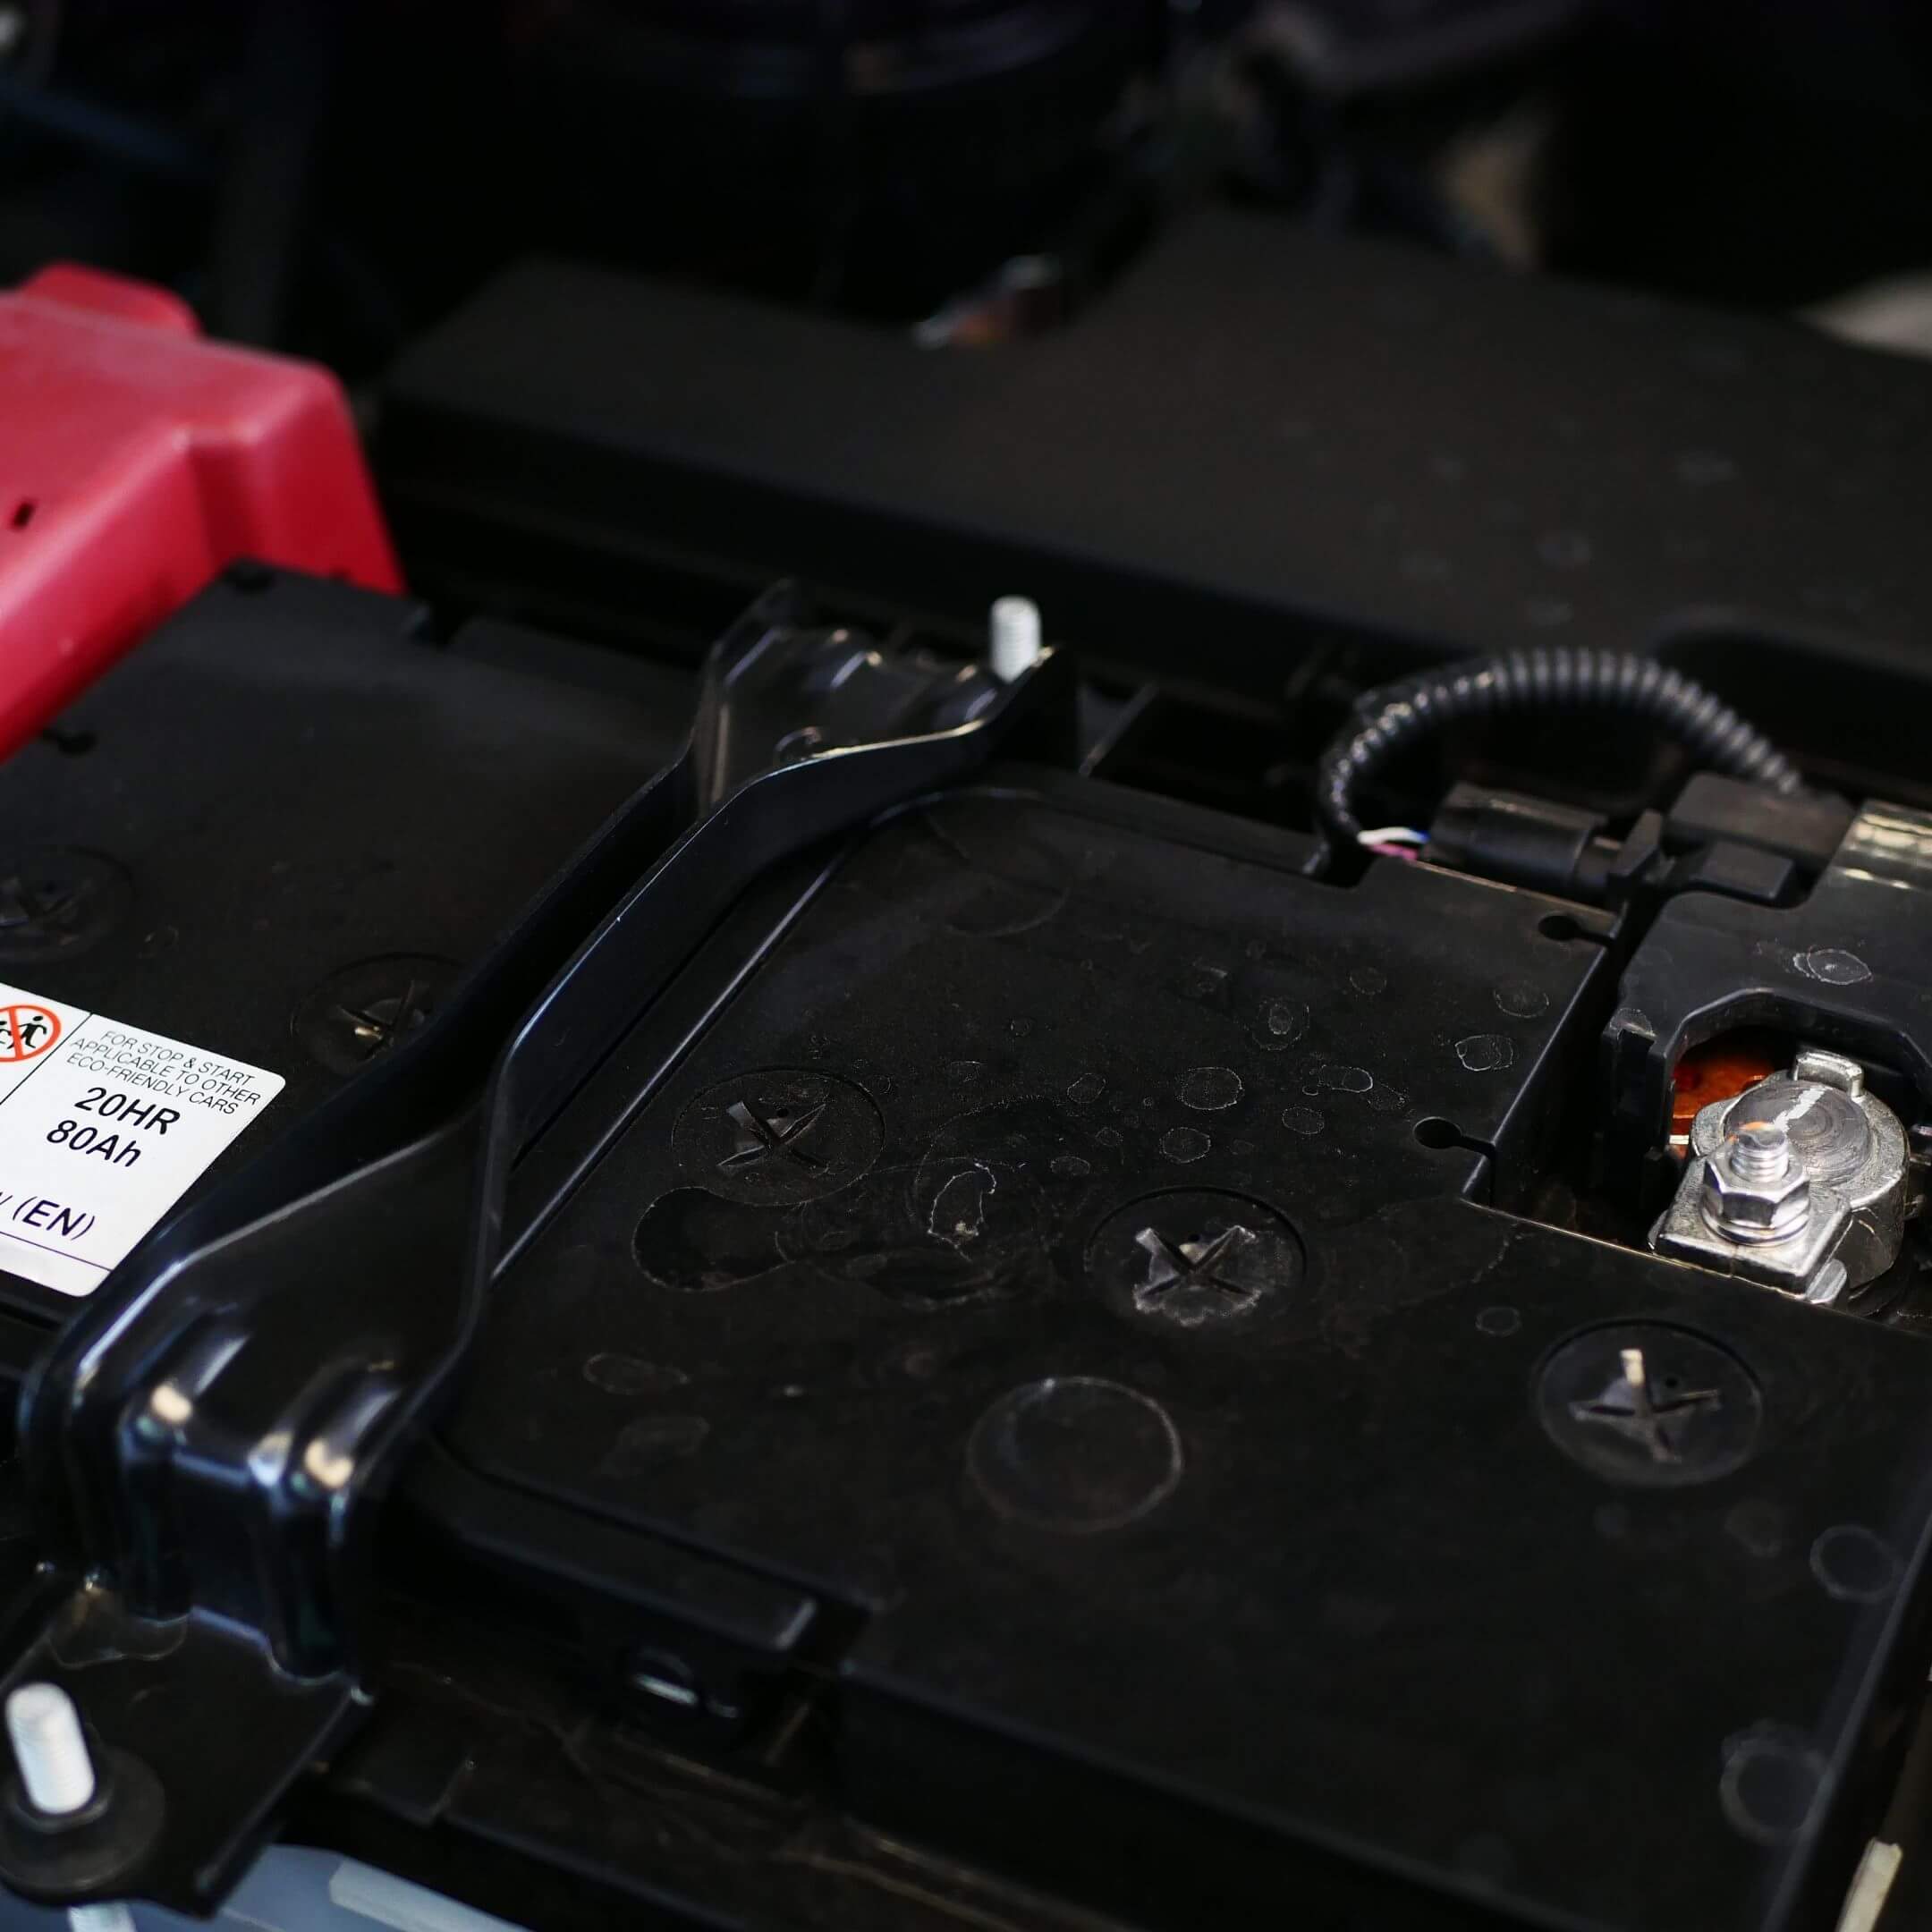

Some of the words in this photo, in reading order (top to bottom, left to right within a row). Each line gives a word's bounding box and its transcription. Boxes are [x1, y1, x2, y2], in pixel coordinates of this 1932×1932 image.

[66, 1052, 191, 1097] ECO-FRIENDLY
[189, 1091, 239, 1114] CARS
[71, 1038, 174, 1078] APPLICABLE
[176, 1070, 199, 1085] TO
[201, 1079, 261, 1106] OTHER
[100, 1030, 138, 1050] FOR
[138, 1043, 184, 1063] STOP
[183, 1057, 198, 1069] &
[199, 1062, 256, 1086] START
[73, 1087, 181, 1135] 20HR
[47, 1120, 141, 1167] 80Ah
[13, 1196, 96, 1241] (EN)
